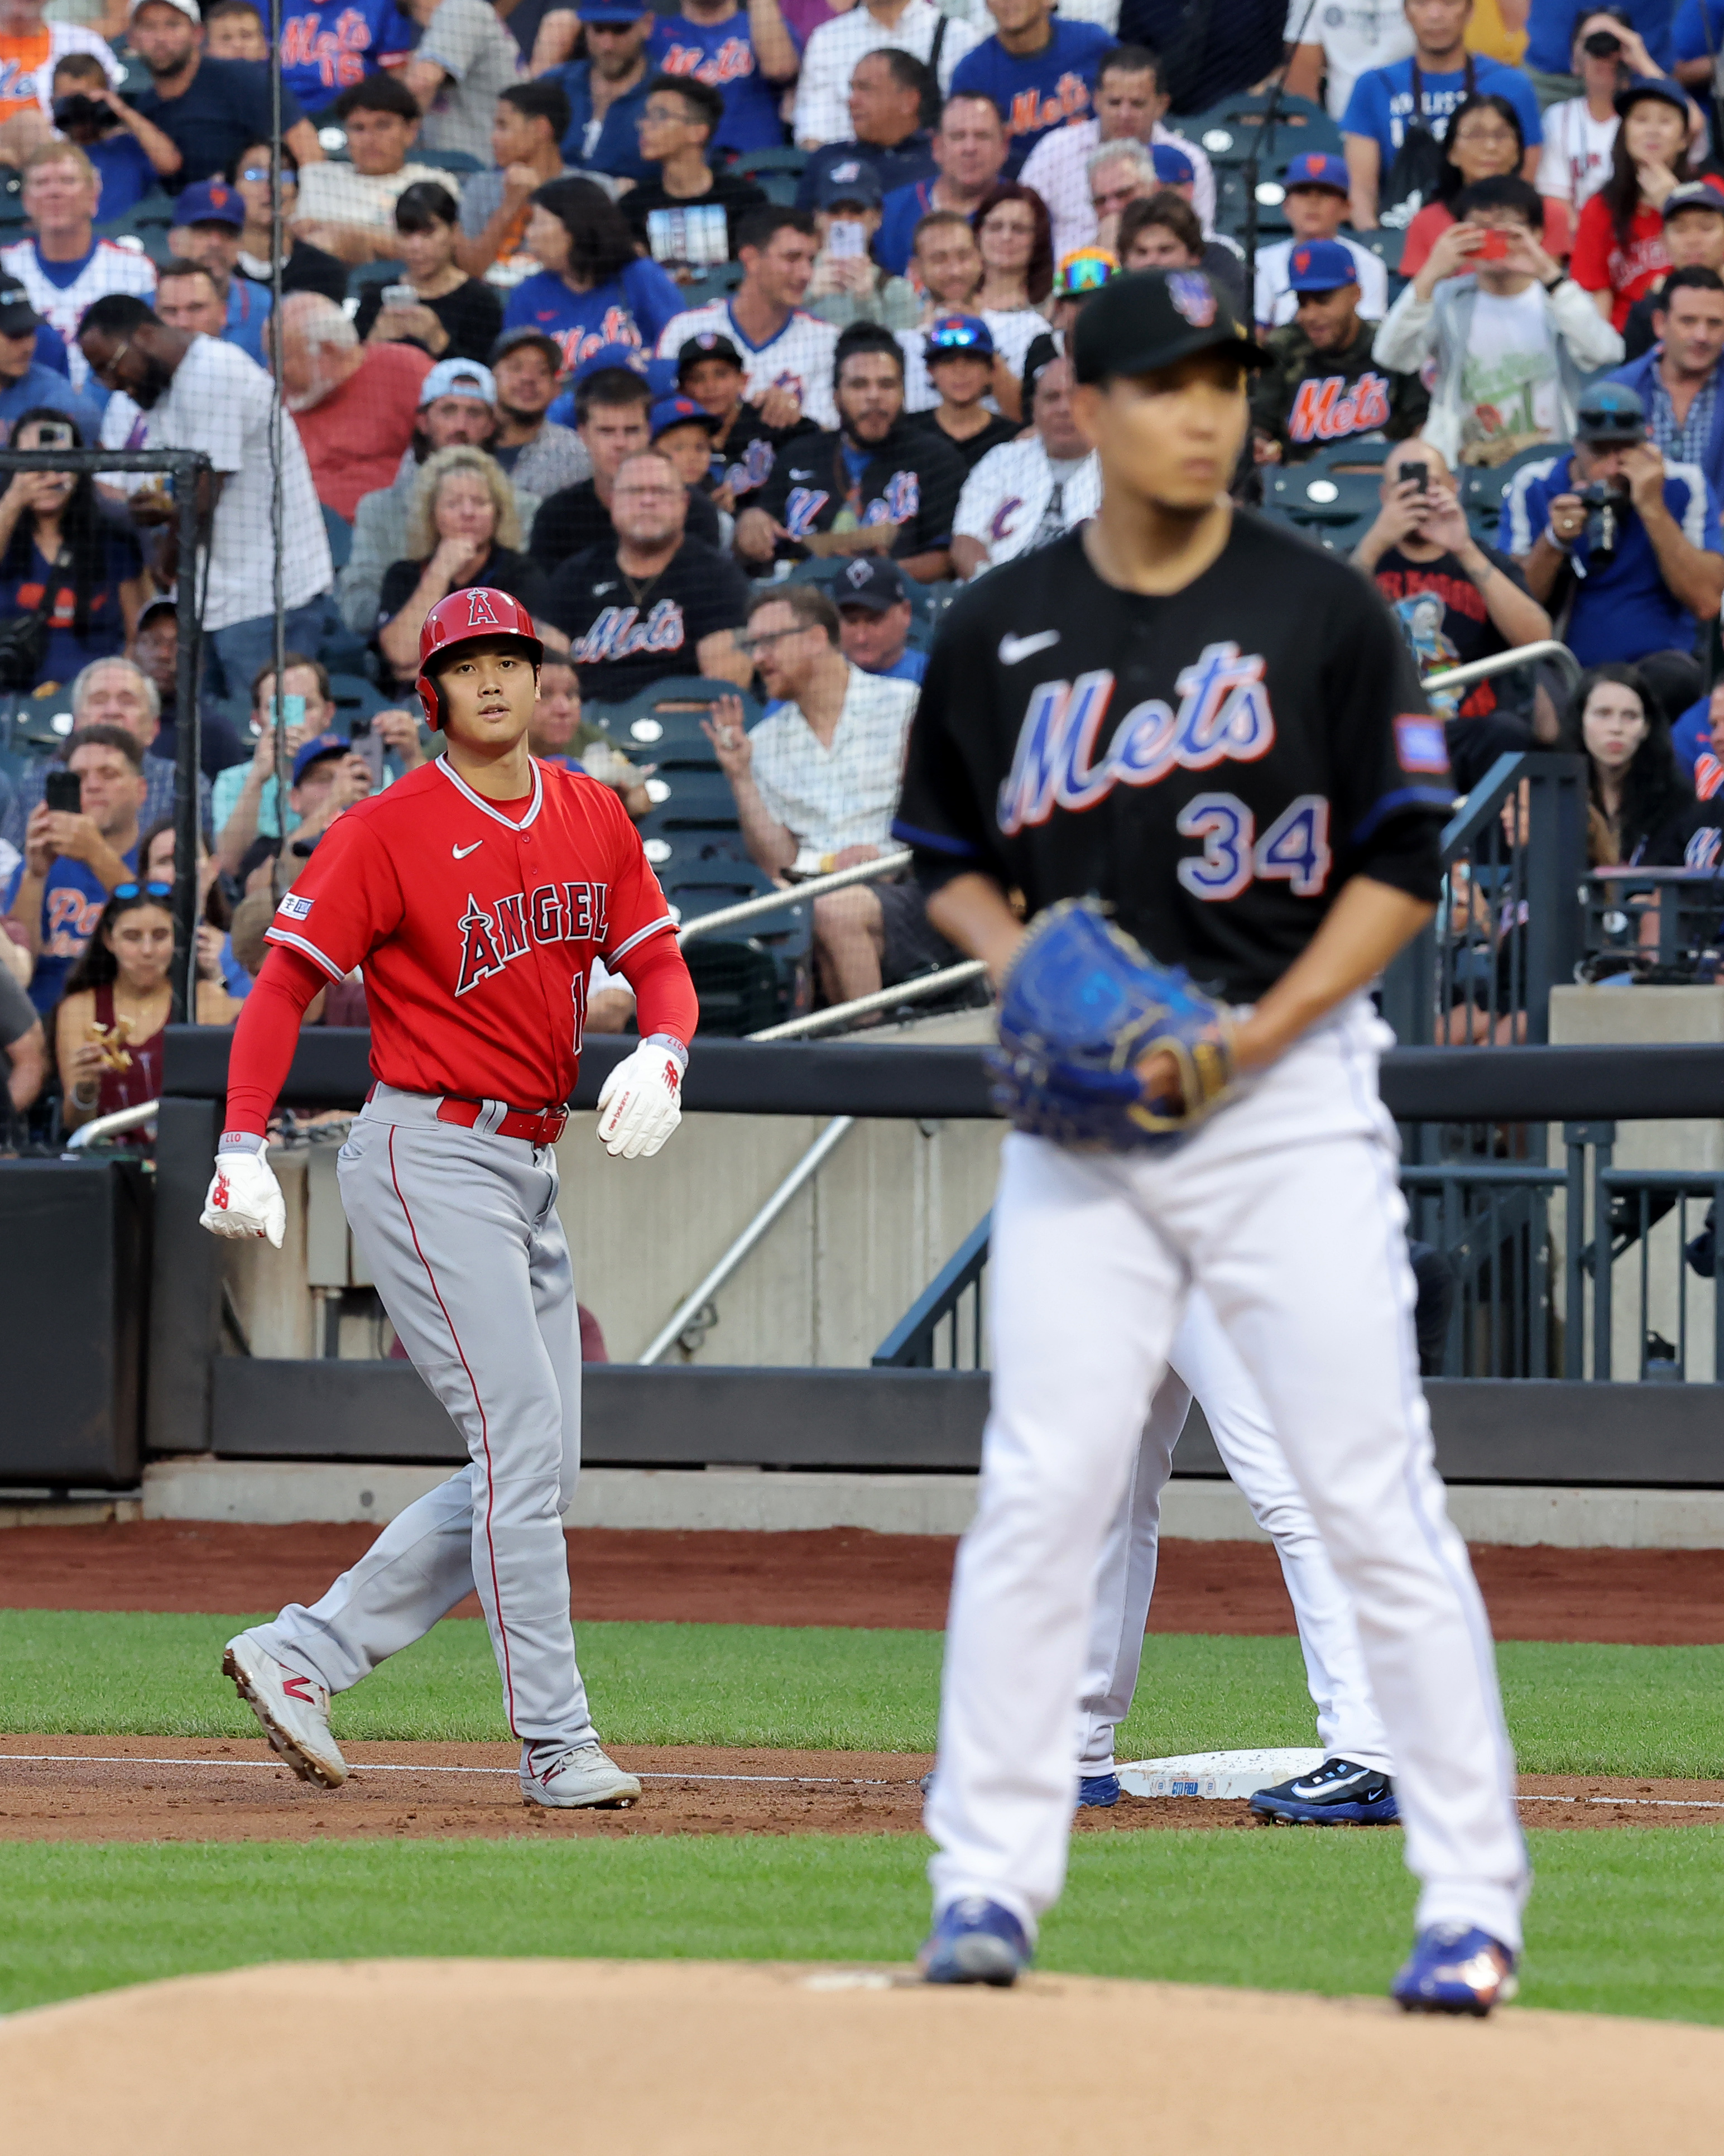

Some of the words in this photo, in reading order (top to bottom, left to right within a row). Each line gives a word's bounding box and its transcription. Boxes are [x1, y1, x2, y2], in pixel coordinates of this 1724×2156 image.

[280, 7, 372, 70] Mets
[661, 37, 755, 87] Mets
[1003, 71, 1090, 136] Mets
[1288, 371, 1391, 443] Mets
[468, 588, 500, 626] A
[570, 598, 686, 664] Mets
[996, 640, 1277, 836] Mets
[1176, 792, 1331, 902] 34
[667, 1037, 684, 1052] 017
[613, 1090, 631, 1119] balance
[225, 1133, 241, 1143] 017
[1184, 1781, 1199, 1795] FIELD
